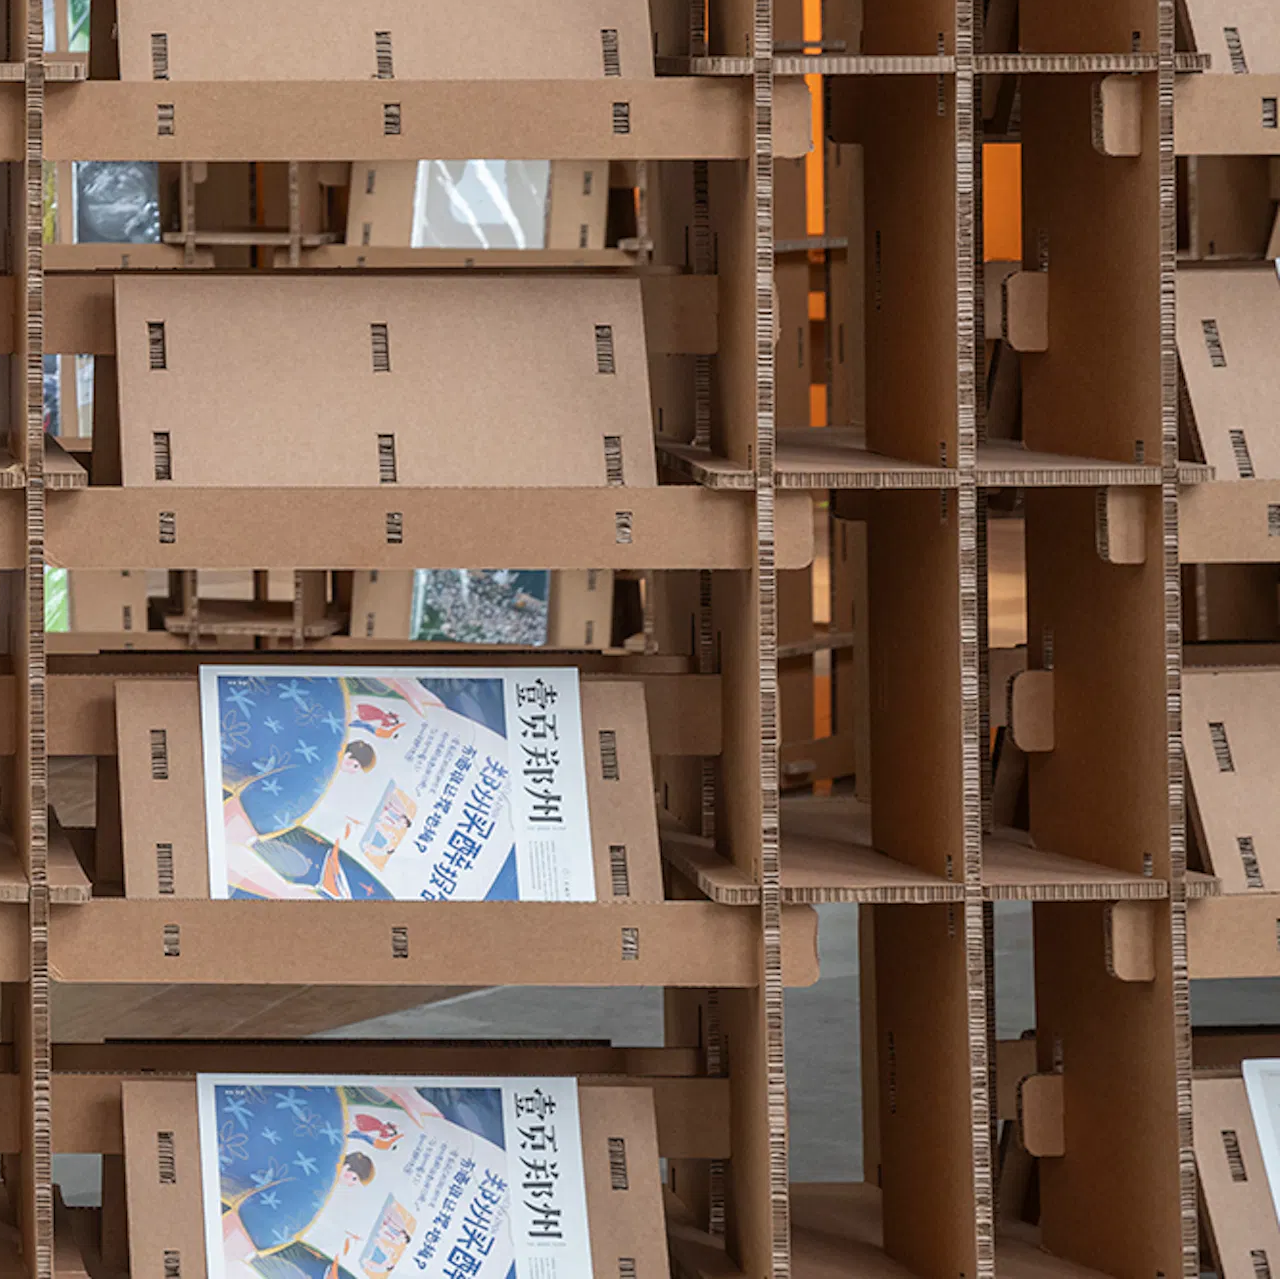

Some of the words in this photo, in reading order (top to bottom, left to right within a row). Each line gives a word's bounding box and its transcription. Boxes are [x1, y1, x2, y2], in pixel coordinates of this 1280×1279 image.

[515, 677, 563, 825] 壹页郑州
[513, 1087, 563, 1240] 壹页郑州
